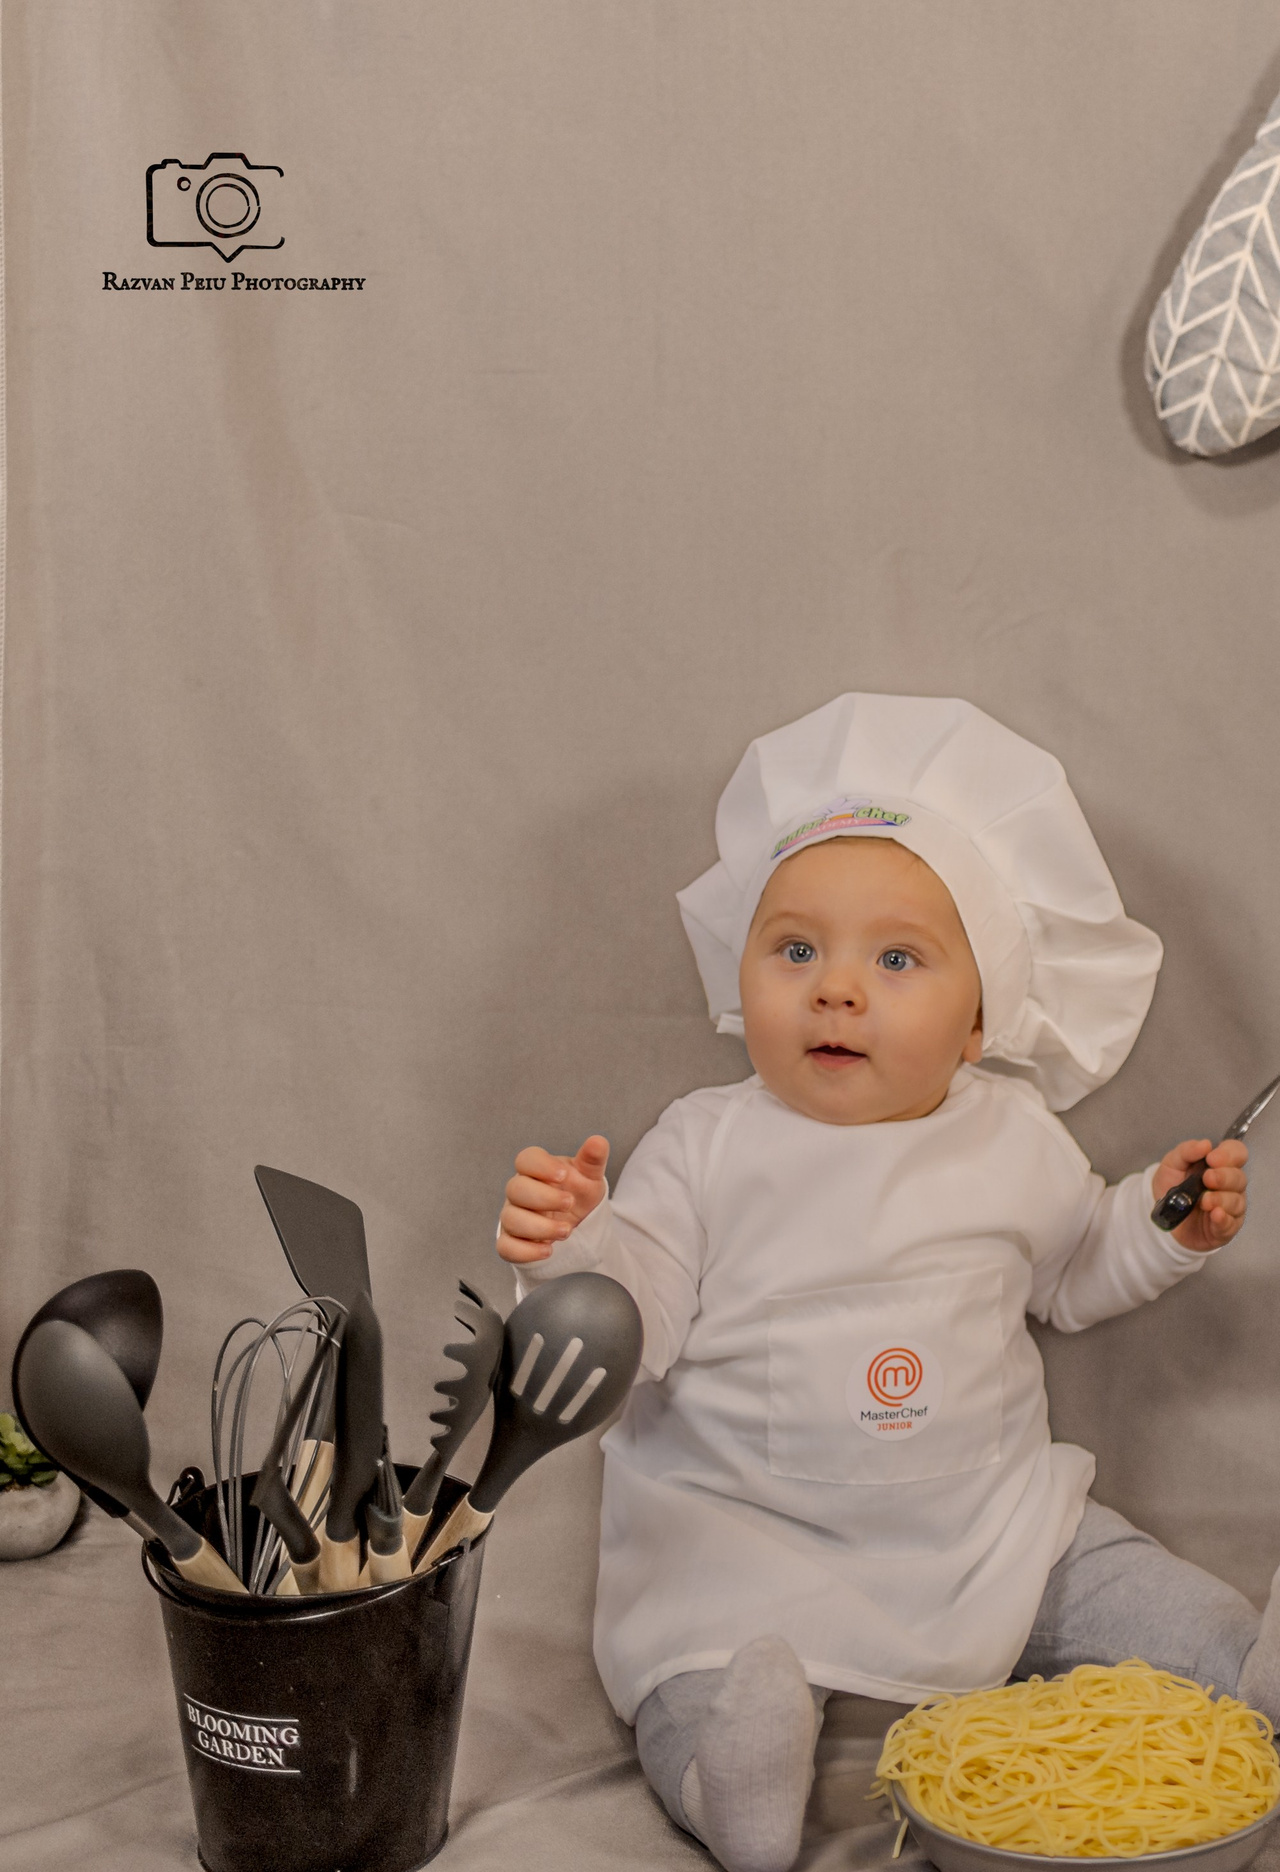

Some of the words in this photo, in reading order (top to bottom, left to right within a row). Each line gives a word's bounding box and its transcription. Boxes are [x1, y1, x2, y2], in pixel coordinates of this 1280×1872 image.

[854, 806, 912, 826] Chef
[860, 1406, 928, 1421] MasterChef
[876, 1421, 913, 1432] JUNIOR
[186, 1702, 300, 1746] BLOOMING
[197, 1729, 286, 1767] GARDEN
